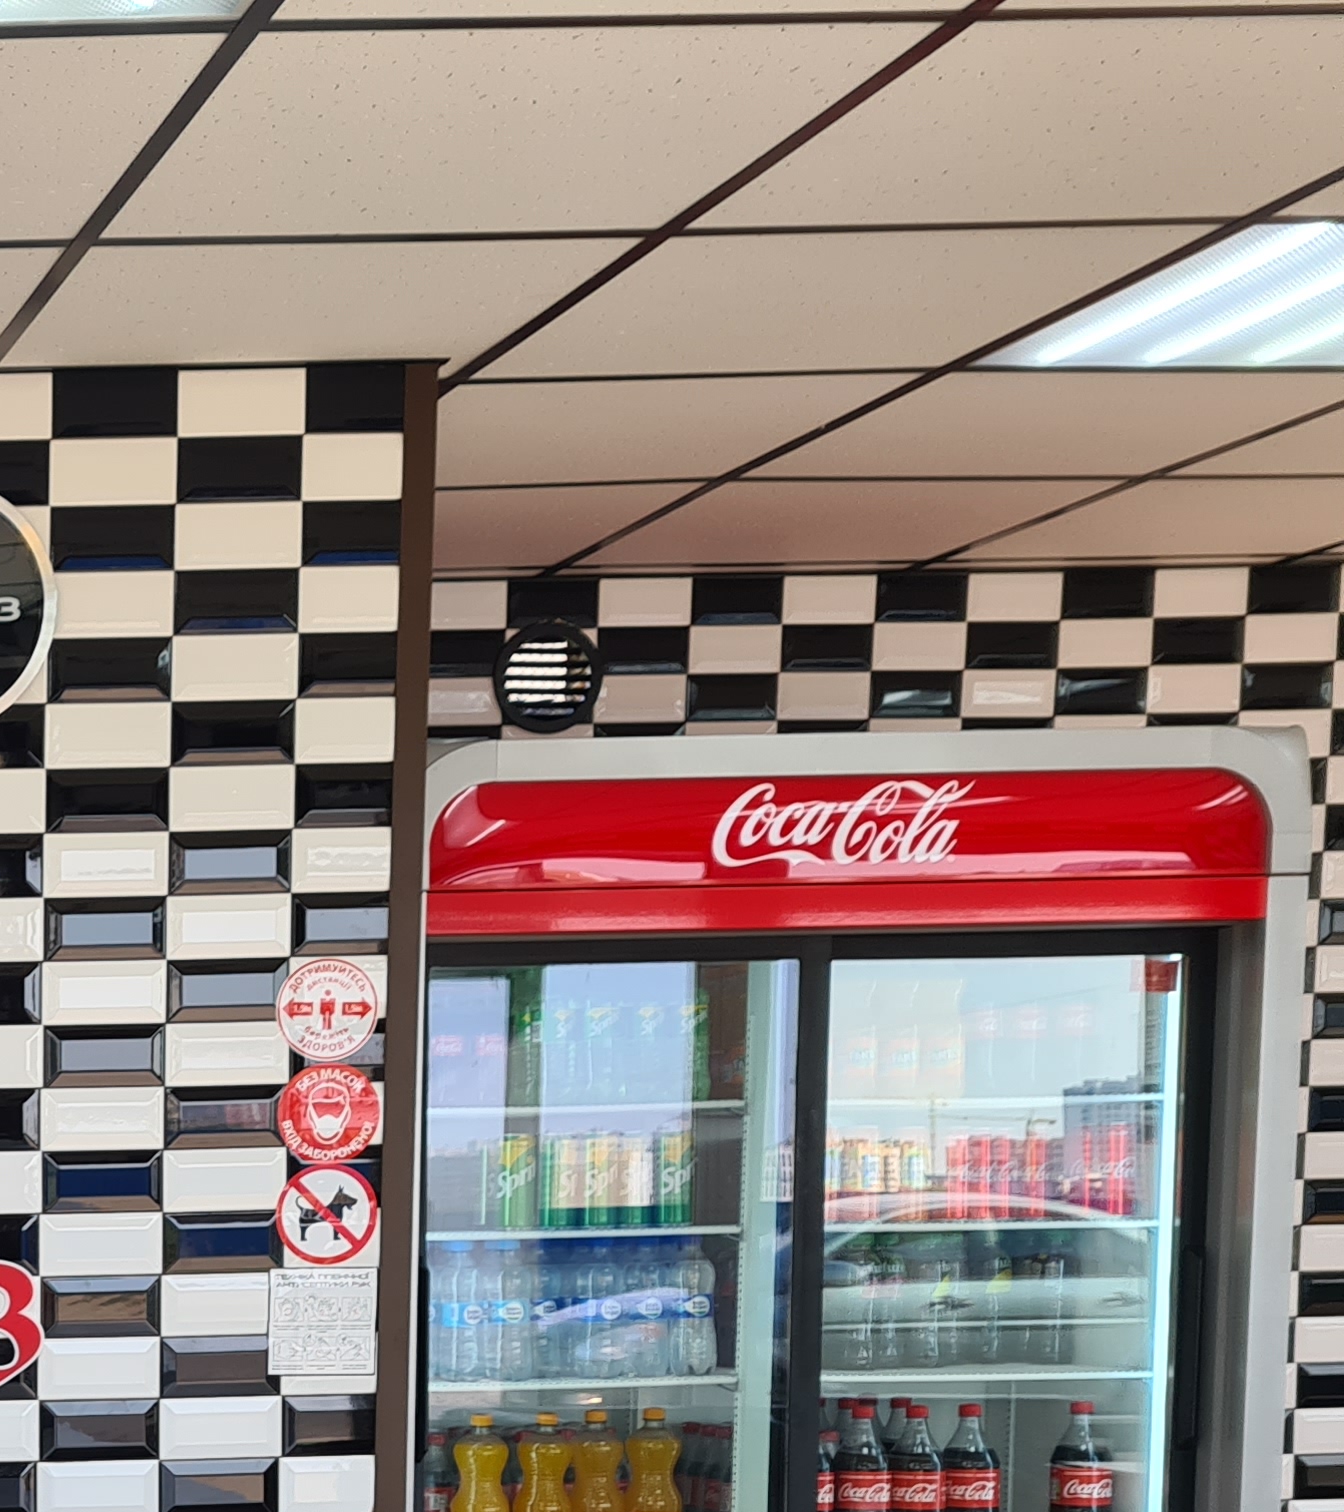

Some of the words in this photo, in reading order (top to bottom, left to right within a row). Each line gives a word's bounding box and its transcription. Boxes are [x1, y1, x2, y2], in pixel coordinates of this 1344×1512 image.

[712, 779, 976, 867] Coca-Cola
[296, 1071, 319, 1092] БЕЗ
[320, 1067, 366, 1093] МАСОК
